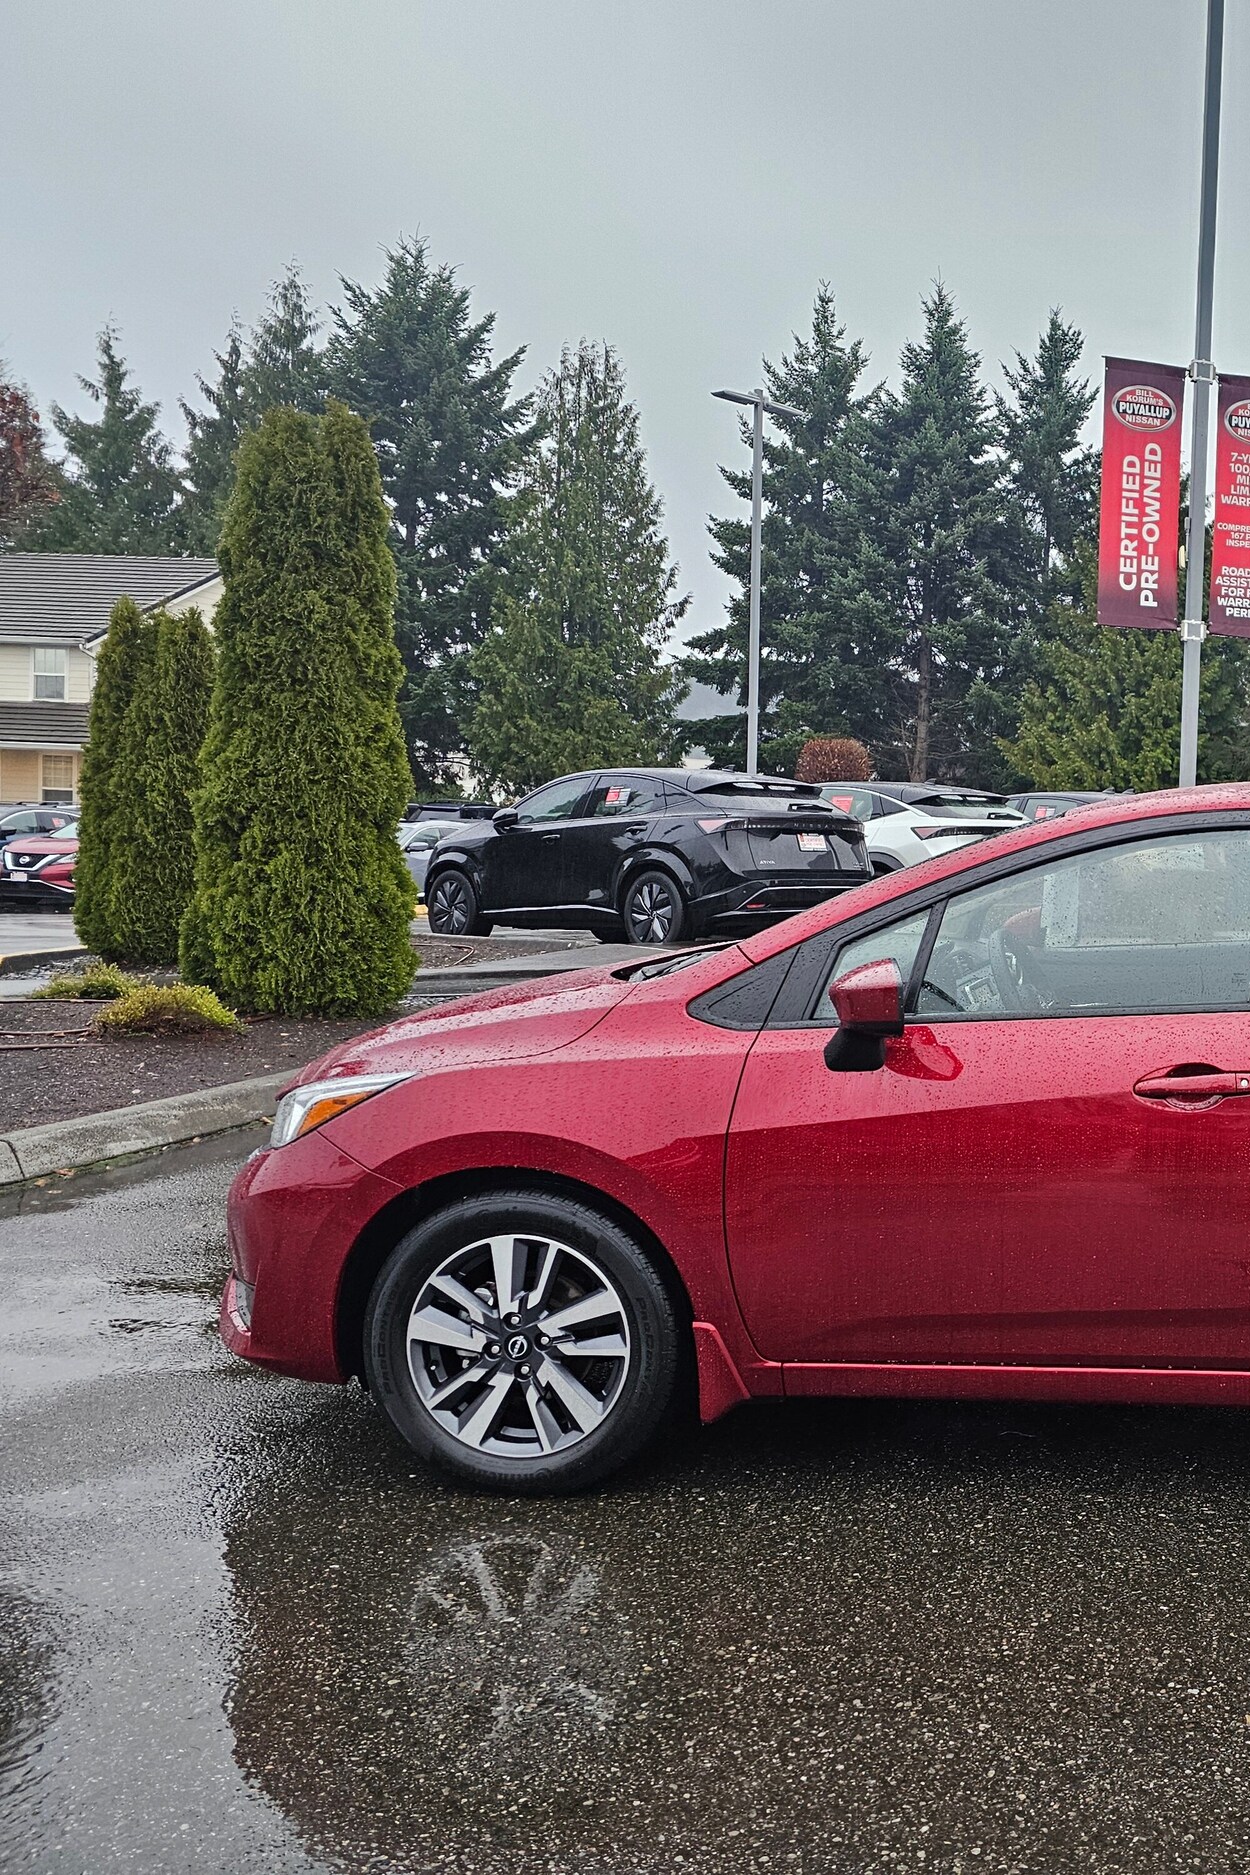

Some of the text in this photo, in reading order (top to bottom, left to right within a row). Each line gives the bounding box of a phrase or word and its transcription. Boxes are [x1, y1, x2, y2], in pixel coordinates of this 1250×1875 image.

[1136, 389, 1154, 398] BILL
[1126, 394, 1164, 406] KORUM'S
[1119, 402, 1170, 418] PUYALLUP
[1125, 414, 1161, 426] NISSAN
[1119, 454, 1141, 591] CERTIFIED
[1140, 442, 1162, 607] PRE-OWNED
[1230, 532, 1243, 540] 167
[1221, 587, 1245, 597] FOR
